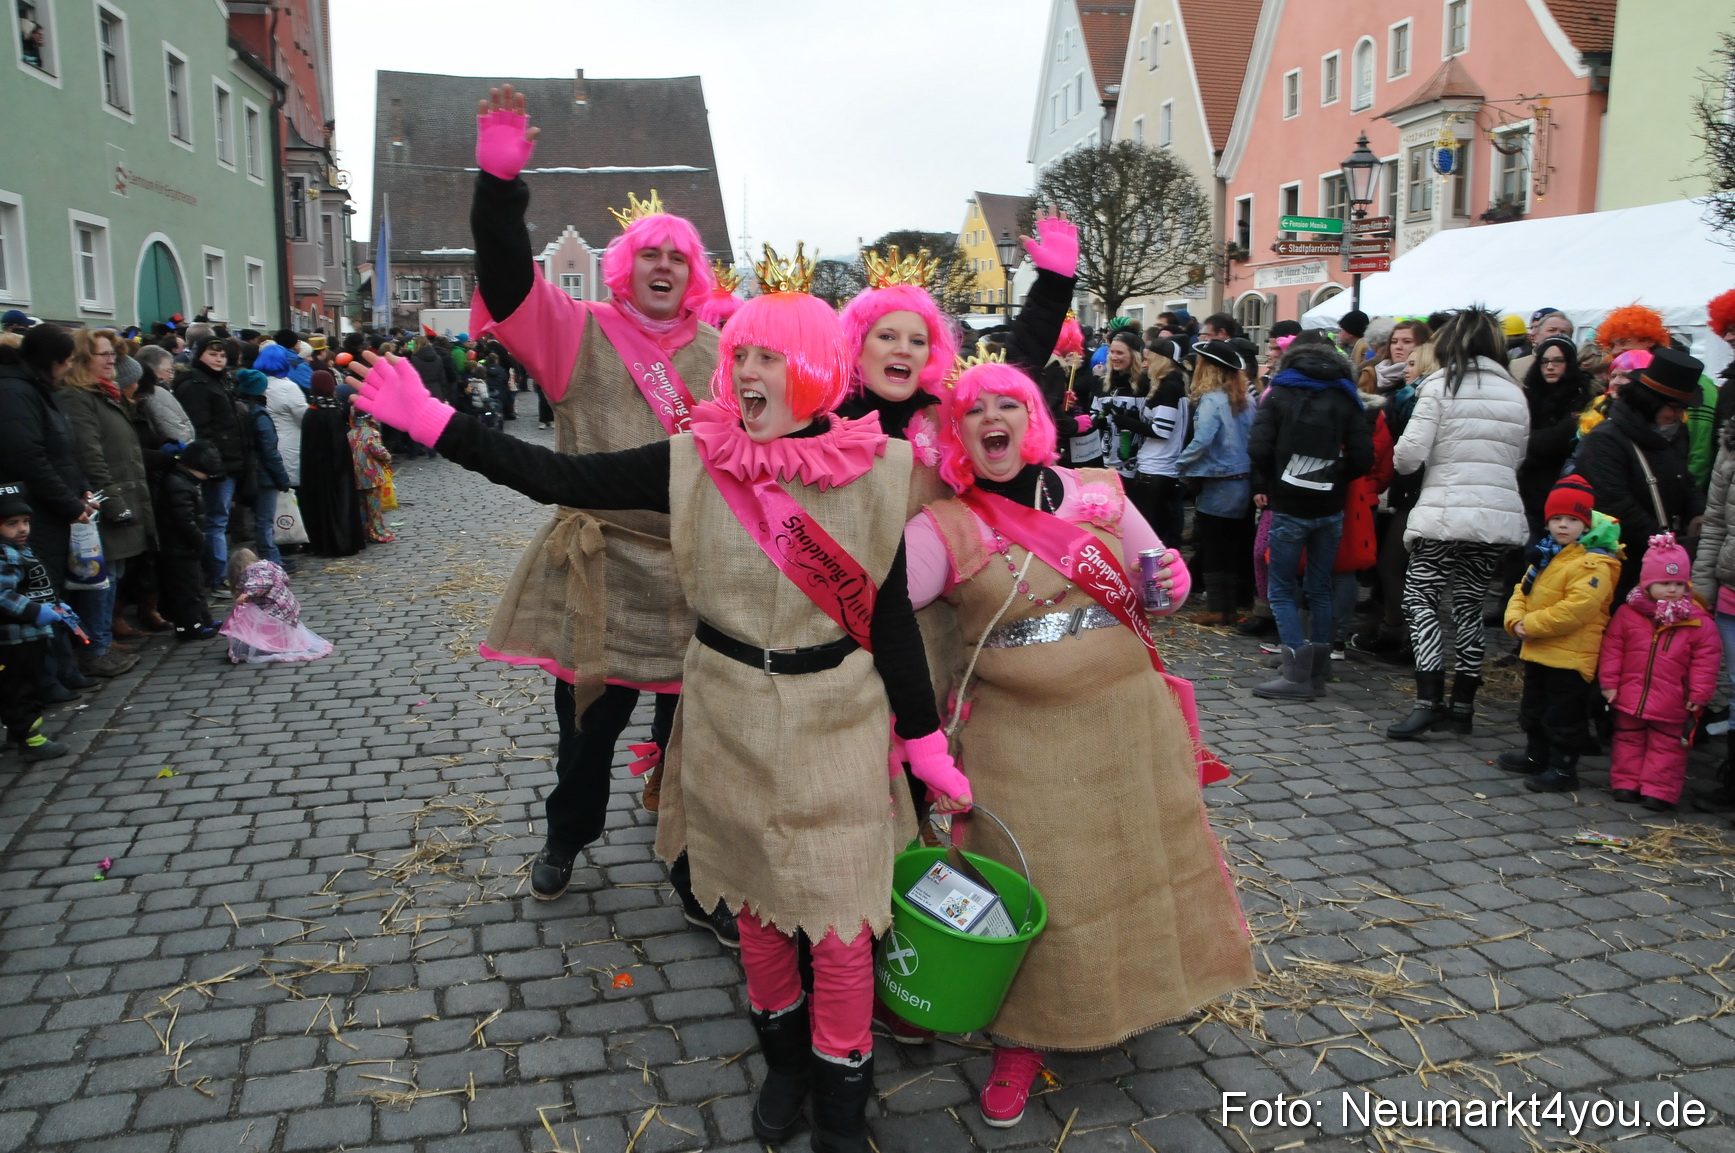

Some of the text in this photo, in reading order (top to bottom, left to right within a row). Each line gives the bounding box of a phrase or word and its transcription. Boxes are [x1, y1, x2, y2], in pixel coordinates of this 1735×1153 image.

[1288, 219, 1328, 230] Pension Monika
[1288, 243, 1340, 255] Stadtpfarrkirche
[650, 361, 690, 417] Shopping
[0, 485, 20, 496] FBI
[782, 515, 872, 639] Shopping Quee
[1080, 544, 1156, 649] Shopping Queen
[875, 964, 932, 1012] aiffeisen
